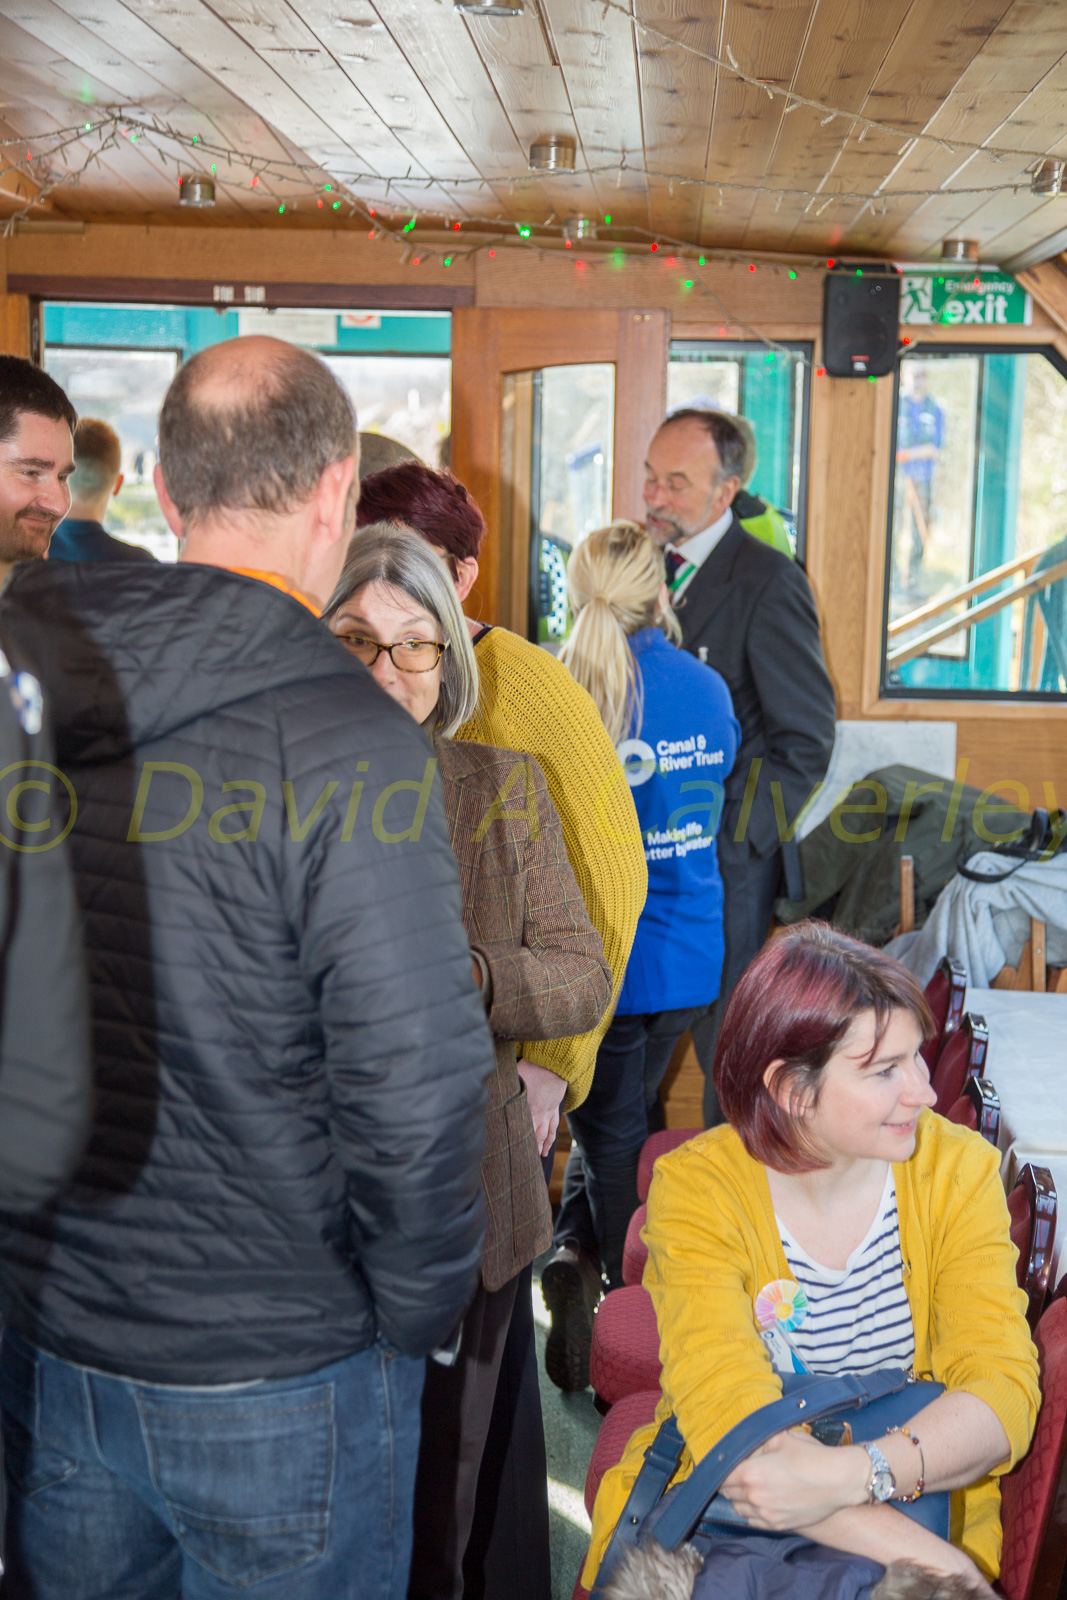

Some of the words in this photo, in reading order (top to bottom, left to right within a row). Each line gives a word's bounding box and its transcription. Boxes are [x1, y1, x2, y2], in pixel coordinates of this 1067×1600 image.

[944, 279, 1015, 295] Emergency
[945, 294, 1008, 323] exit
[656, 736, 696, 756] Canal
[659, 755, 694, 772] River
[693, 750, 724, 767] Trust
[675, 842, 687, 858] by
